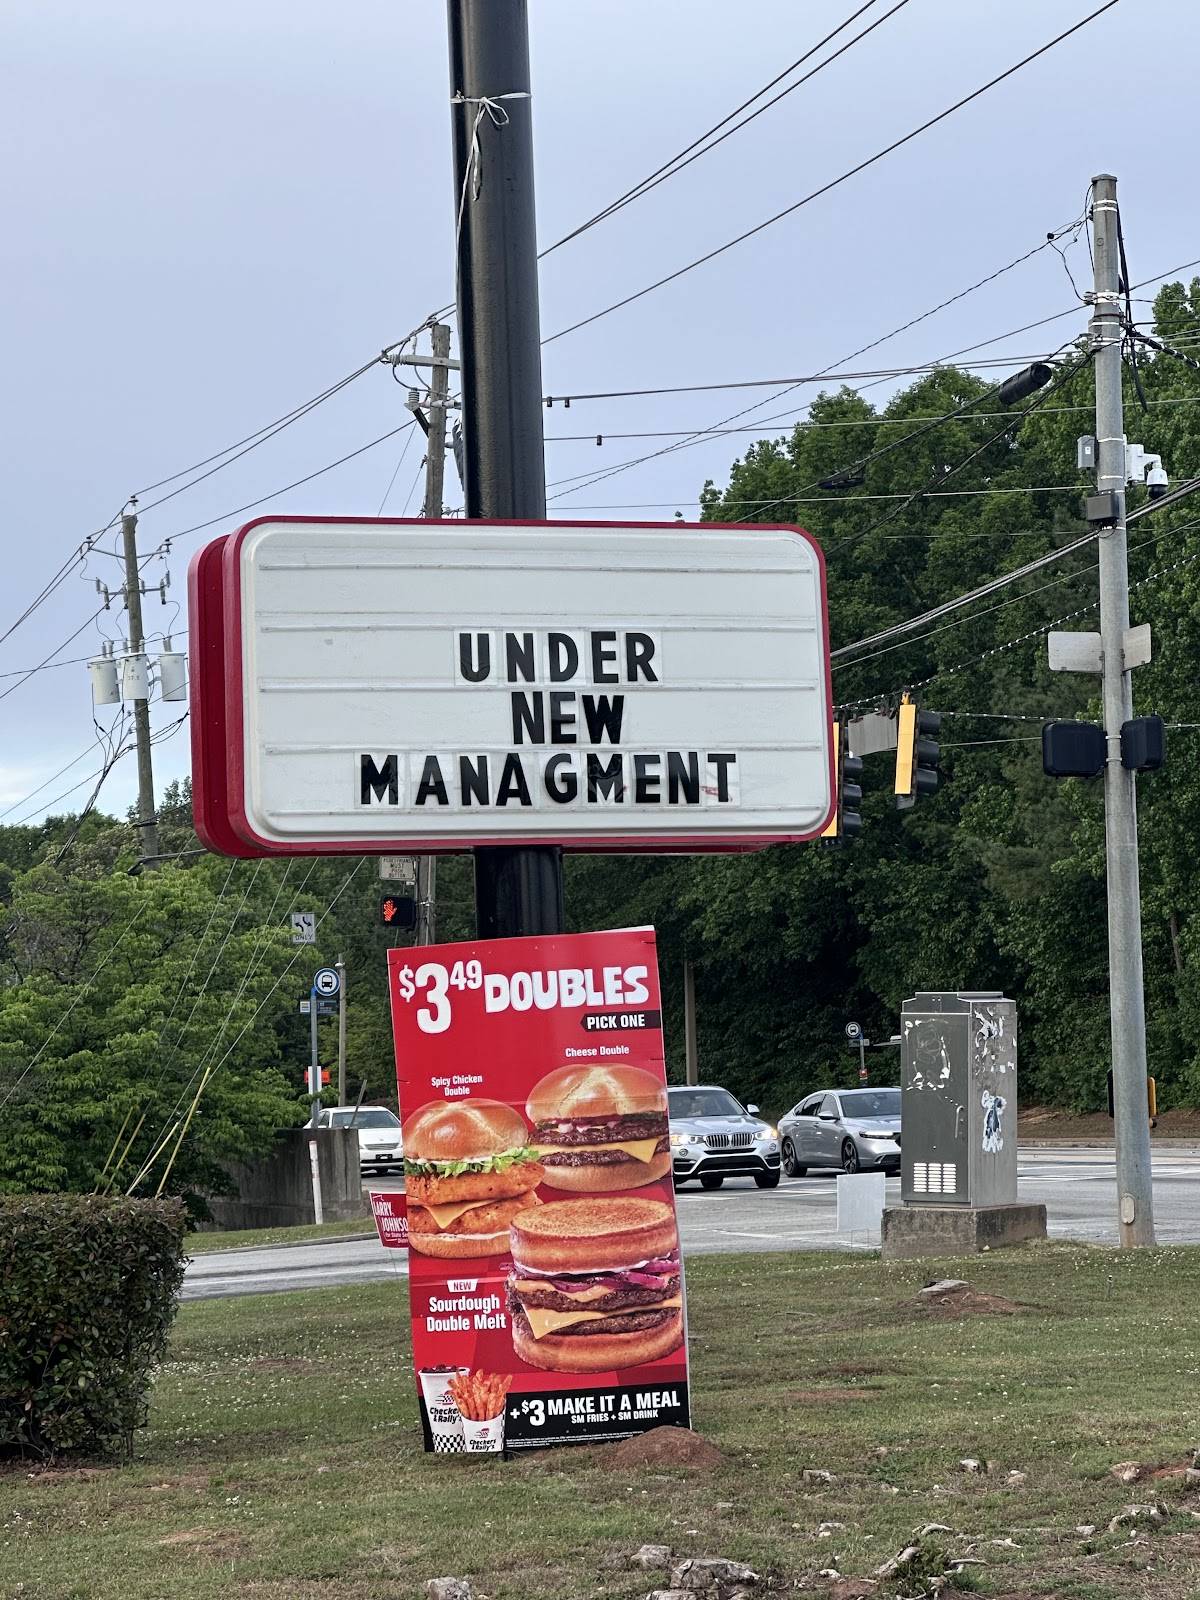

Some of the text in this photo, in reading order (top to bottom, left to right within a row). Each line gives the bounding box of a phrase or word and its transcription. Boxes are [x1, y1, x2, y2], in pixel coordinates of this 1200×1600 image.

[459, 631, 659, 684] UNDER
[511, 691, 625, 745] NEW
[360, 751, 737, 807] MANAGMENT
[295, 933, 314, 941] ONLY
[483, 966, 649, 1013] DOUBLES
[587, 1013, 646, 1030] PICK ONE
[565, 1045, 629, 1057] Cheese Double
[431, 1074, 483, 1087] Spicy Chicken
[444, 1086, 470, 1096] Double
[381, 1217, 408, 1232] JOHNSO
[453, 1281, 472, 1291] NEW
[429, 1294, 500, 1314] Sourdough
[426, 1313, 506, 1332] Double Melt
[430, 1407, 460, 1415] Checke
[548, 1397, 595, 1416] MAKE
[600, 1395, 616, 1412] IT
[620, 1394, 632, 1411] A
[636, 1391, 681, 1410] MEAL
[571, 1414, 585, 1424] SM
[587, 1413, 609, 1423] FRIES
[618, 1411, 632, 1421] SM
[633, 1409, 659, 1420] DRINK
